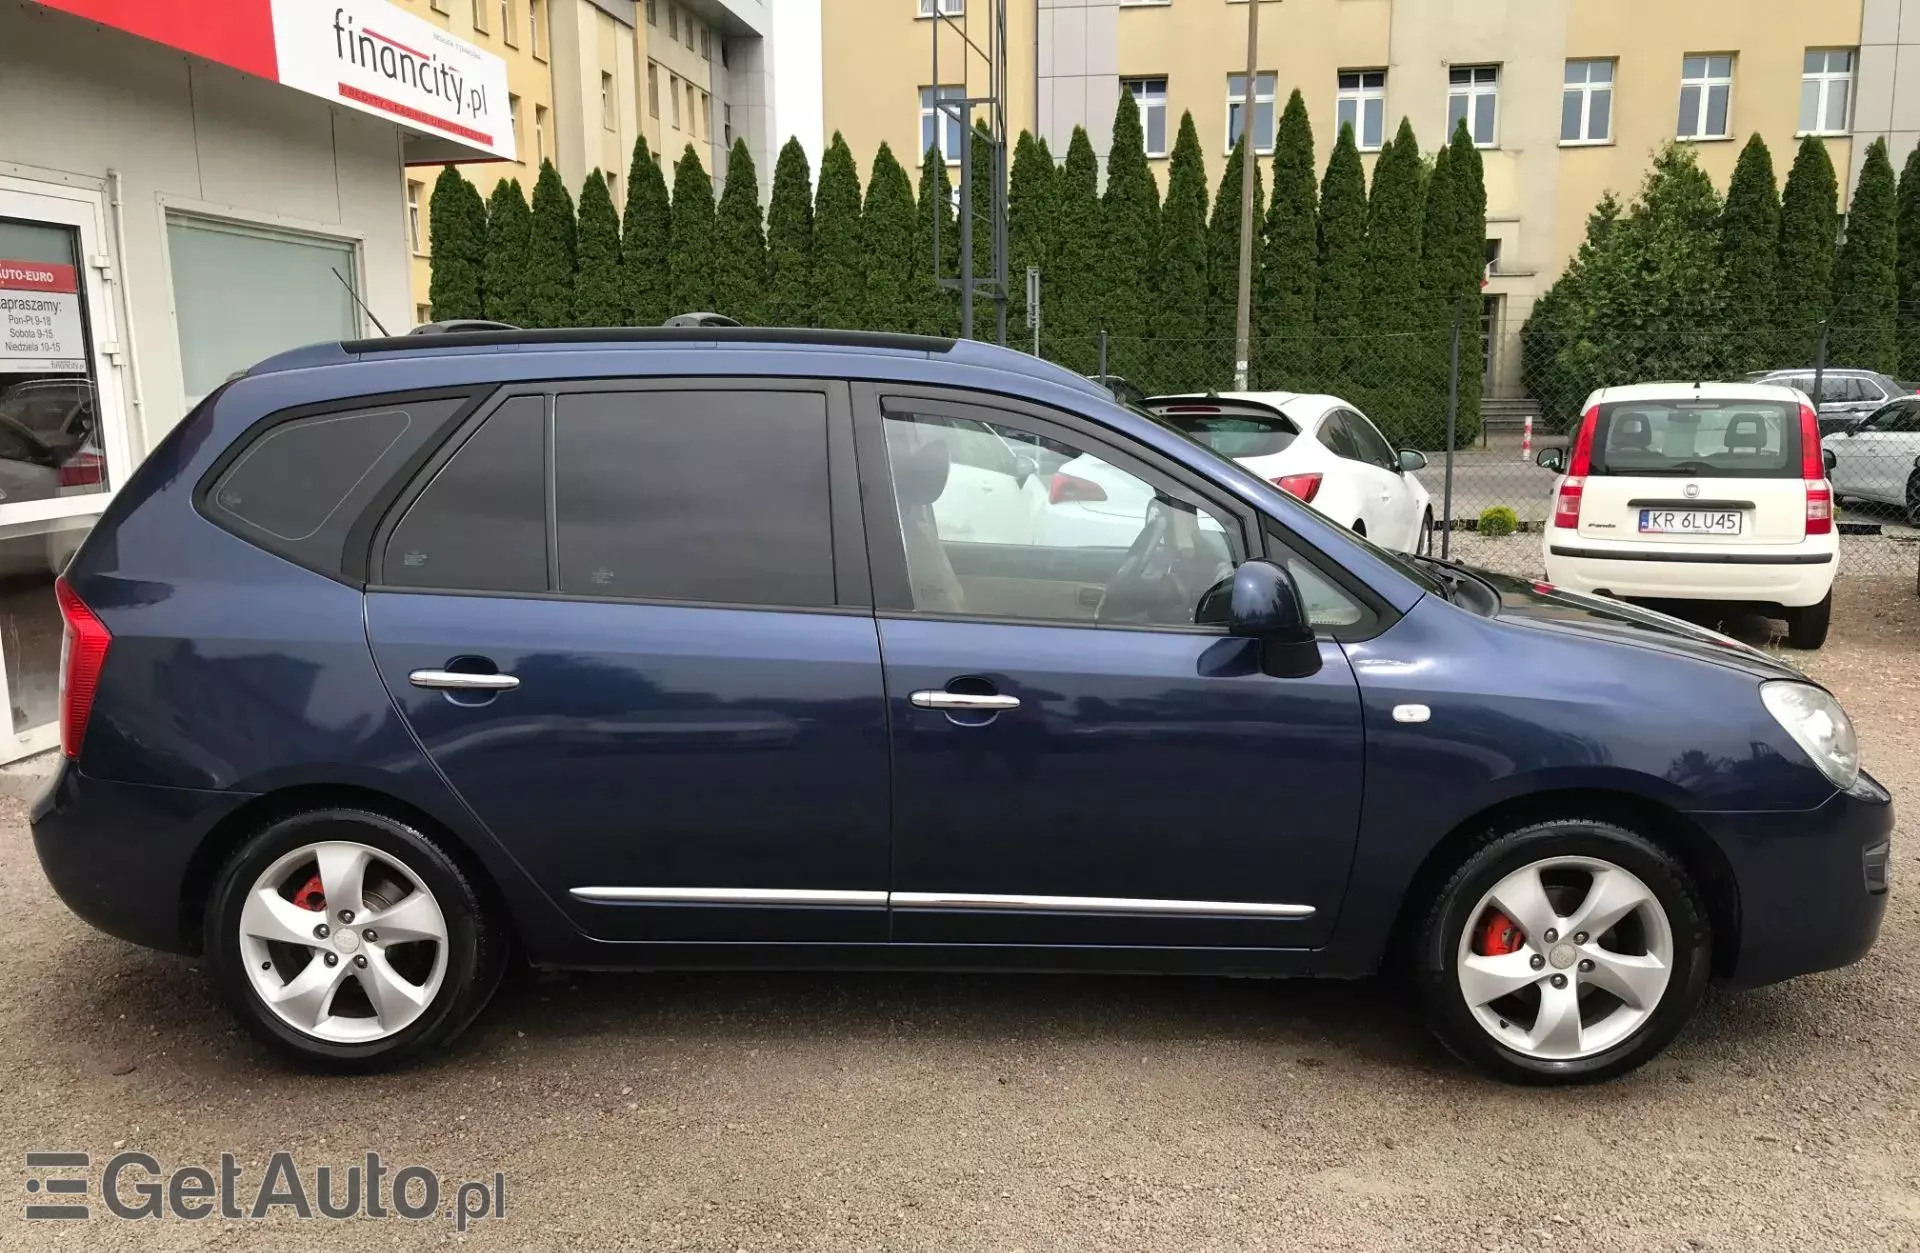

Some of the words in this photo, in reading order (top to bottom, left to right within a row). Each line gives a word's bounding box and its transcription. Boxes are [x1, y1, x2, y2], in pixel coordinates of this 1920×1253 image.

[333, 8, 488, 119] financity.pl
[0, 298, 62, 315] apraszamy:
[9, 328, 35, 338] Sobota
[5, 341, 38, 352] Niedziela
[1652, 513, 1675, 528] KR
[1681, 513, 1736, 529] 6LU45
